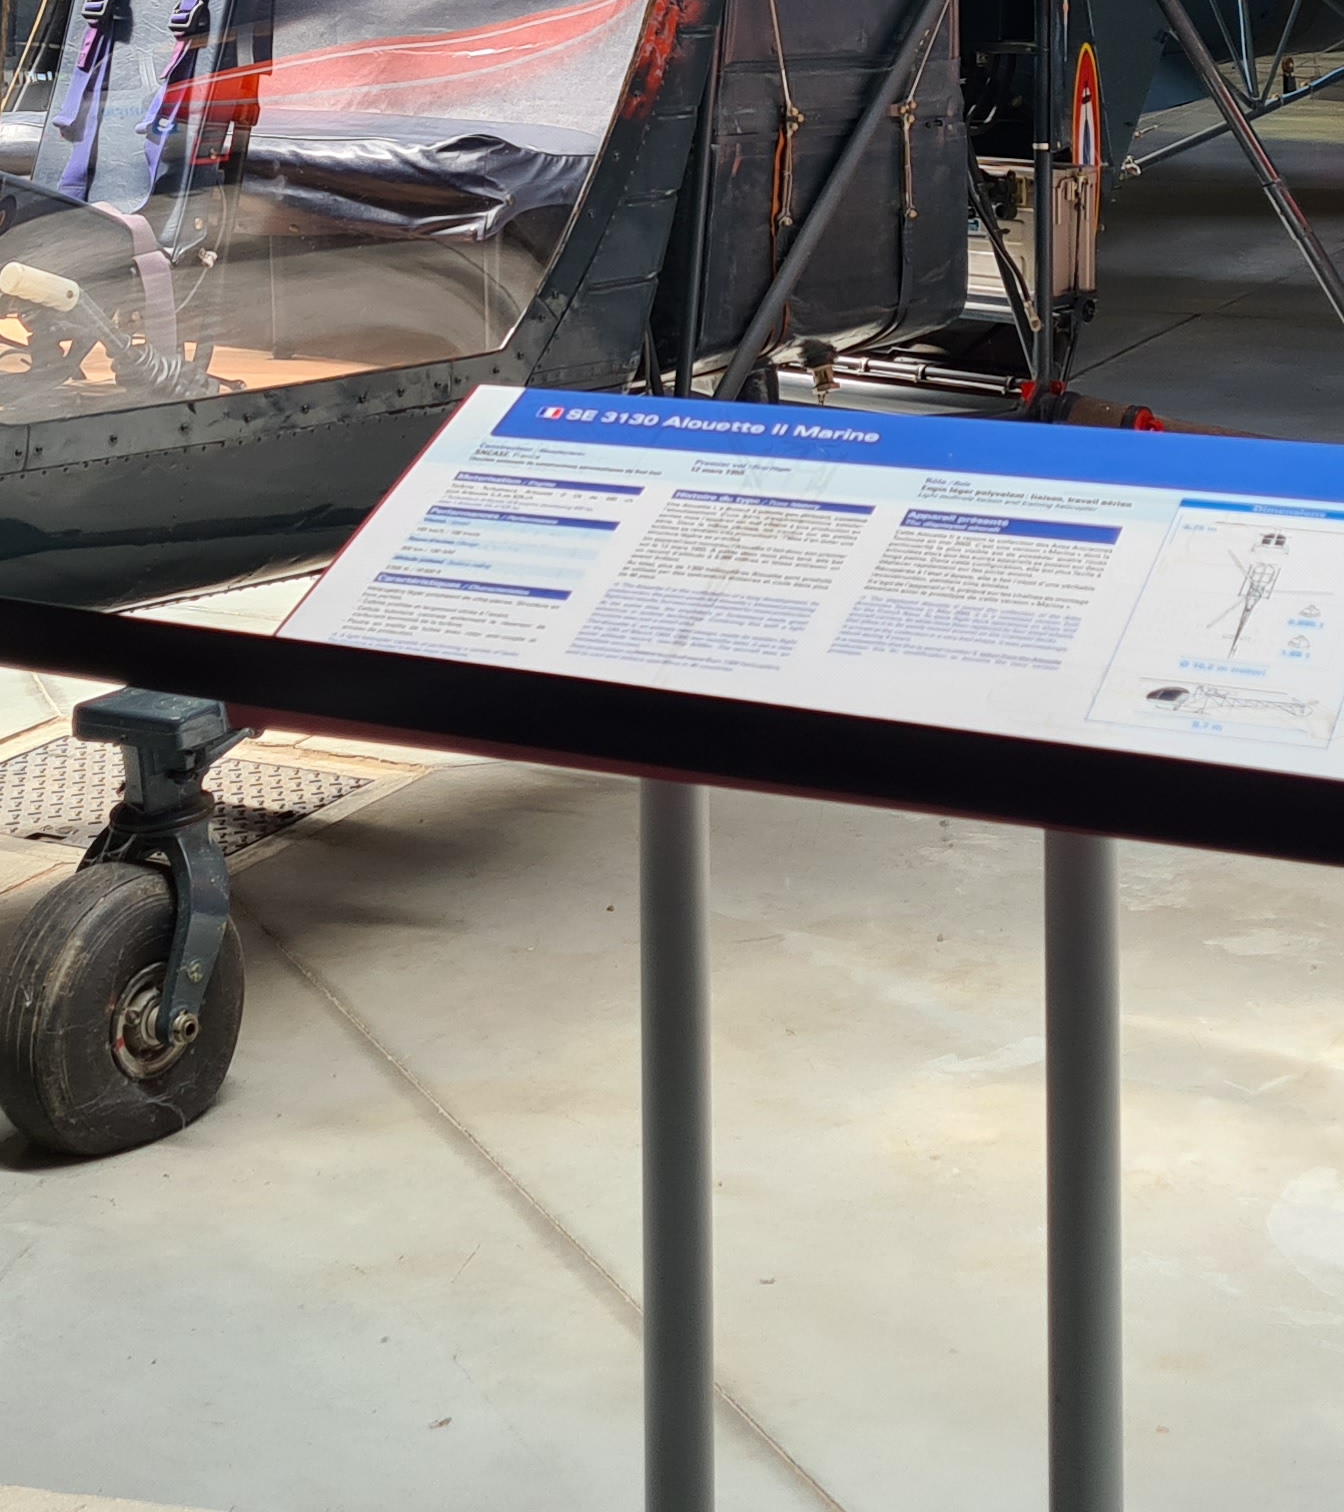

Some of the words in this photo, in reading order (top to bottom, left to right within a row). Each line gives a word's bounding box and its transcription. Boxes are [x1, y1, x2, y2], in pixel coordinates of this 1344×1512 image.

[565, 407, 598, 423] SE
[600, 410, 660, 427] 3130
[662, 414, 766, 435] Alouette
[770, 422, 789, 436] II
[793, 424, 880, 443] Marine
